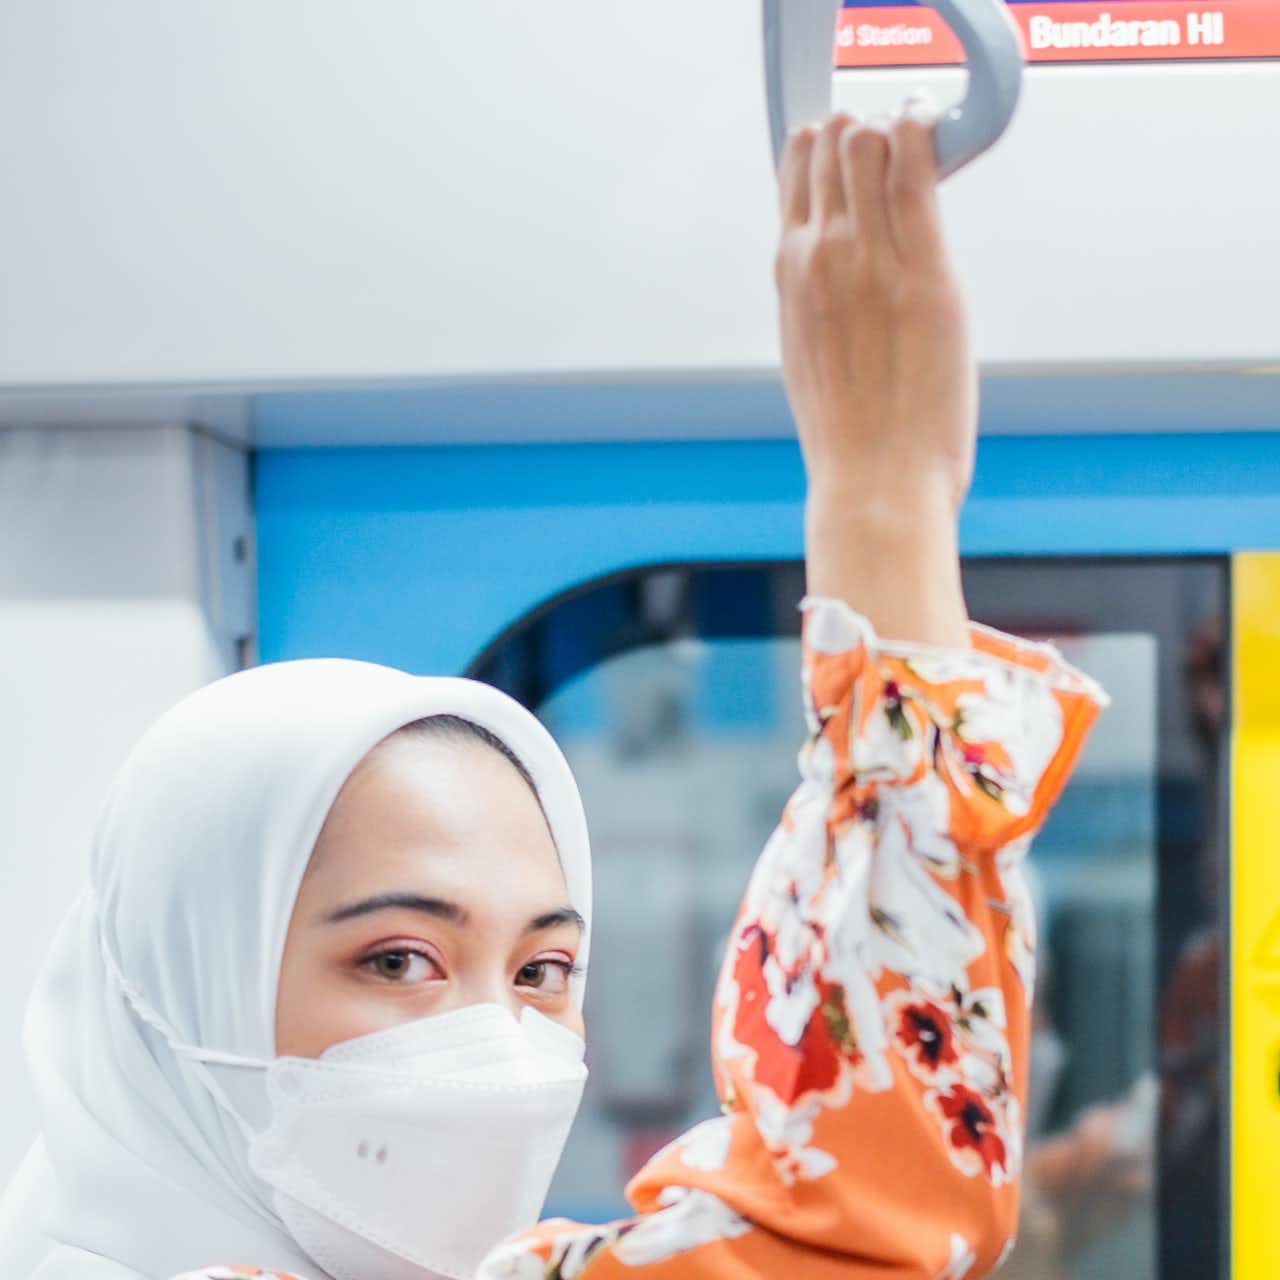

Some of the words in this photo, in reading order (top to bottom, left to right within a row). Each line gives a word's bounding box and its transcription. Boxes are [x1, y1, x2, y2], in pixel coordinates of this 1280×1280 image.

[856, 24, 933, 46] Station
[1029, 14, 1180, 49] Bundaran
[1186, 12, 1224, 46] HI
